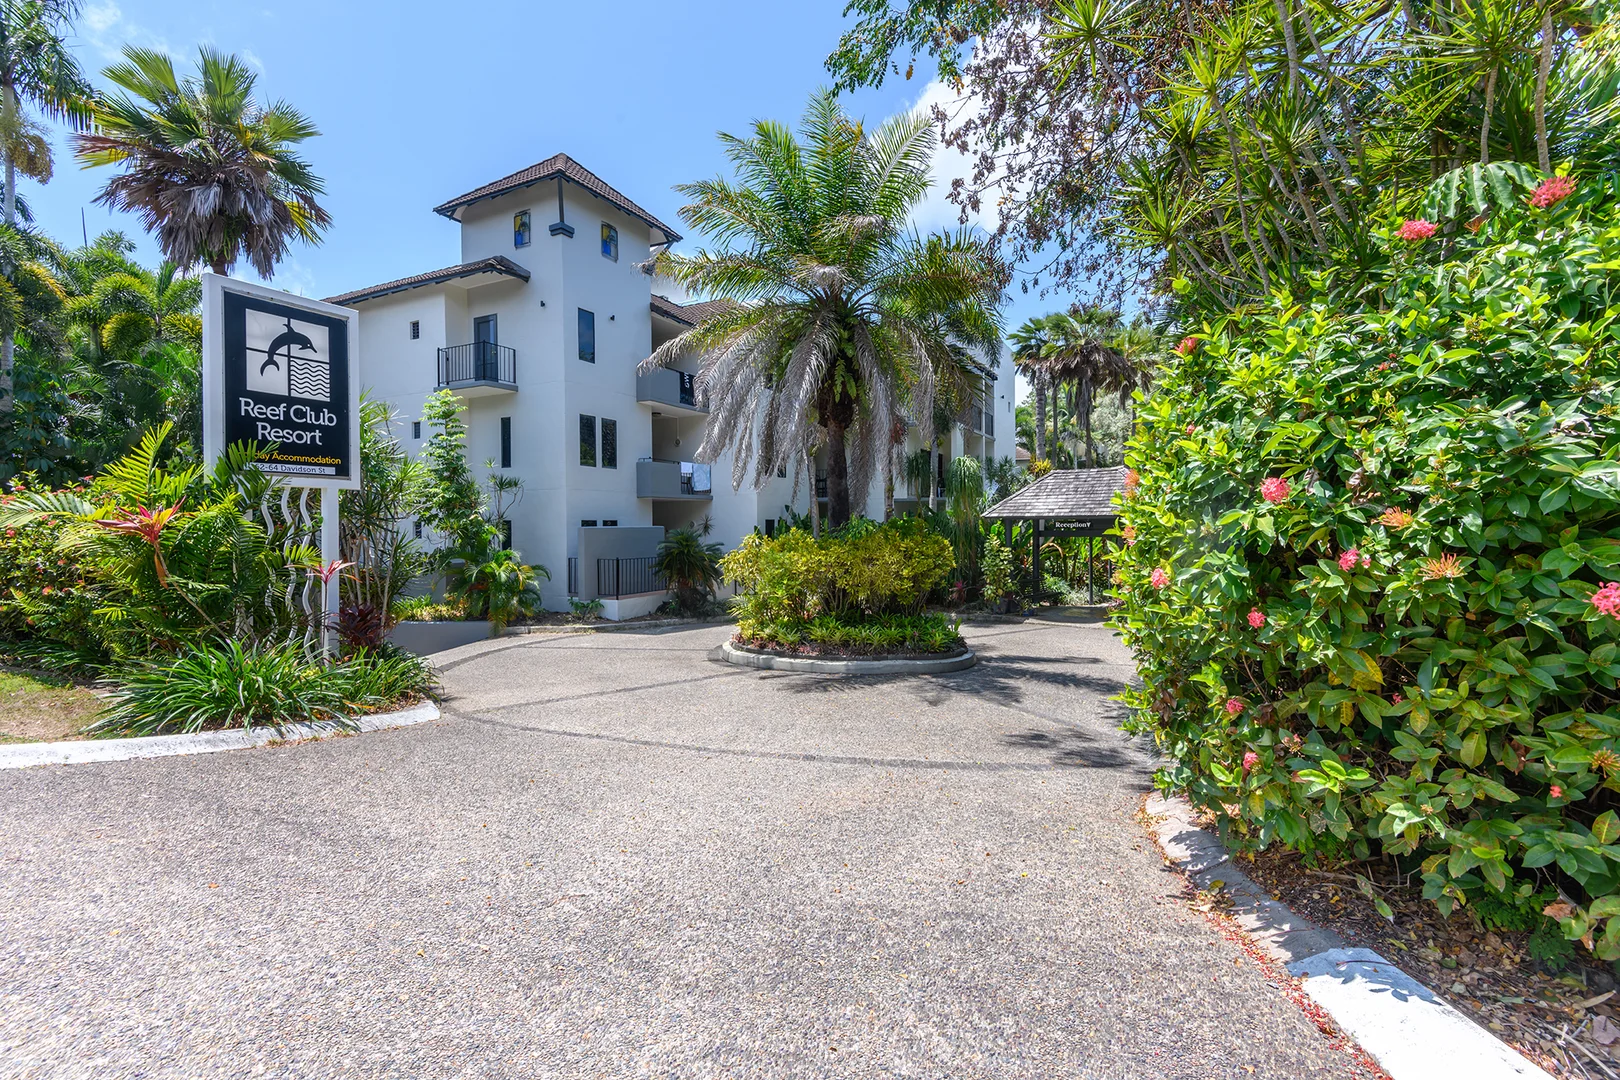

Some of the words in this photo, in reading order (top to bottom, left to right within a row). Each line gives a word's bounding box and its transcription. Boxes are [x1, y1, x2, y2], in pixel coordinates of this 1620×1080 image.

[239, 397, 287, 421] Reef
[289, 404, 337, 426] Club
[256, 421, 322, 445] Resort
[272, 452, 342, 464] Accommodation
[280, 465, 317, 473] Davidson
[318, 466, 326, 474] St
